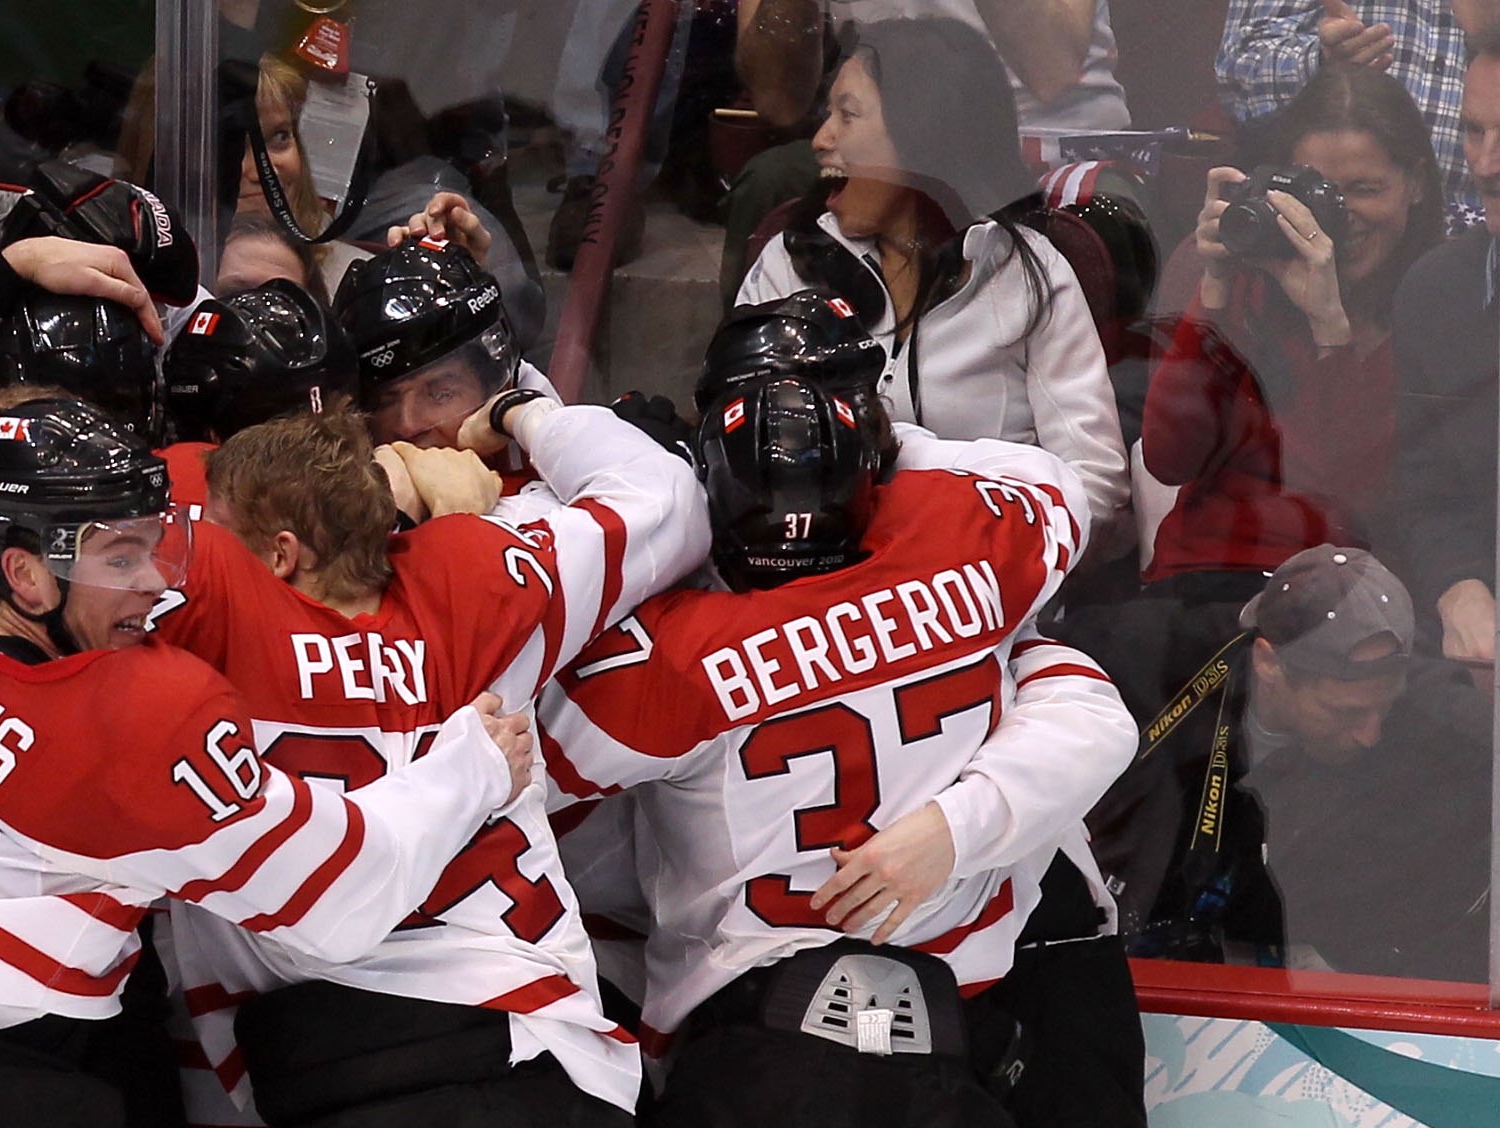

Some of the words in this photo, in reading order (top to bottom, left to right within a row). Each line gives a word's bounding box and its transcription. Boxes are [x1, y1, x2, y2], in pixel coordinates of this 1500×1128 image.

[466, 285, 499, 315] Reebo
[784, 512, 813, 540] 37
[746, 555, 815, 569] vancouver
[700, 559, 1006, 723] BERGERON
[1149, 694, 1192, 742] Nikon
[172, 717, 264, 824] 16
[737, 650, 1003, 932] 37
[1201, 774, 1222, 836] Nikon
